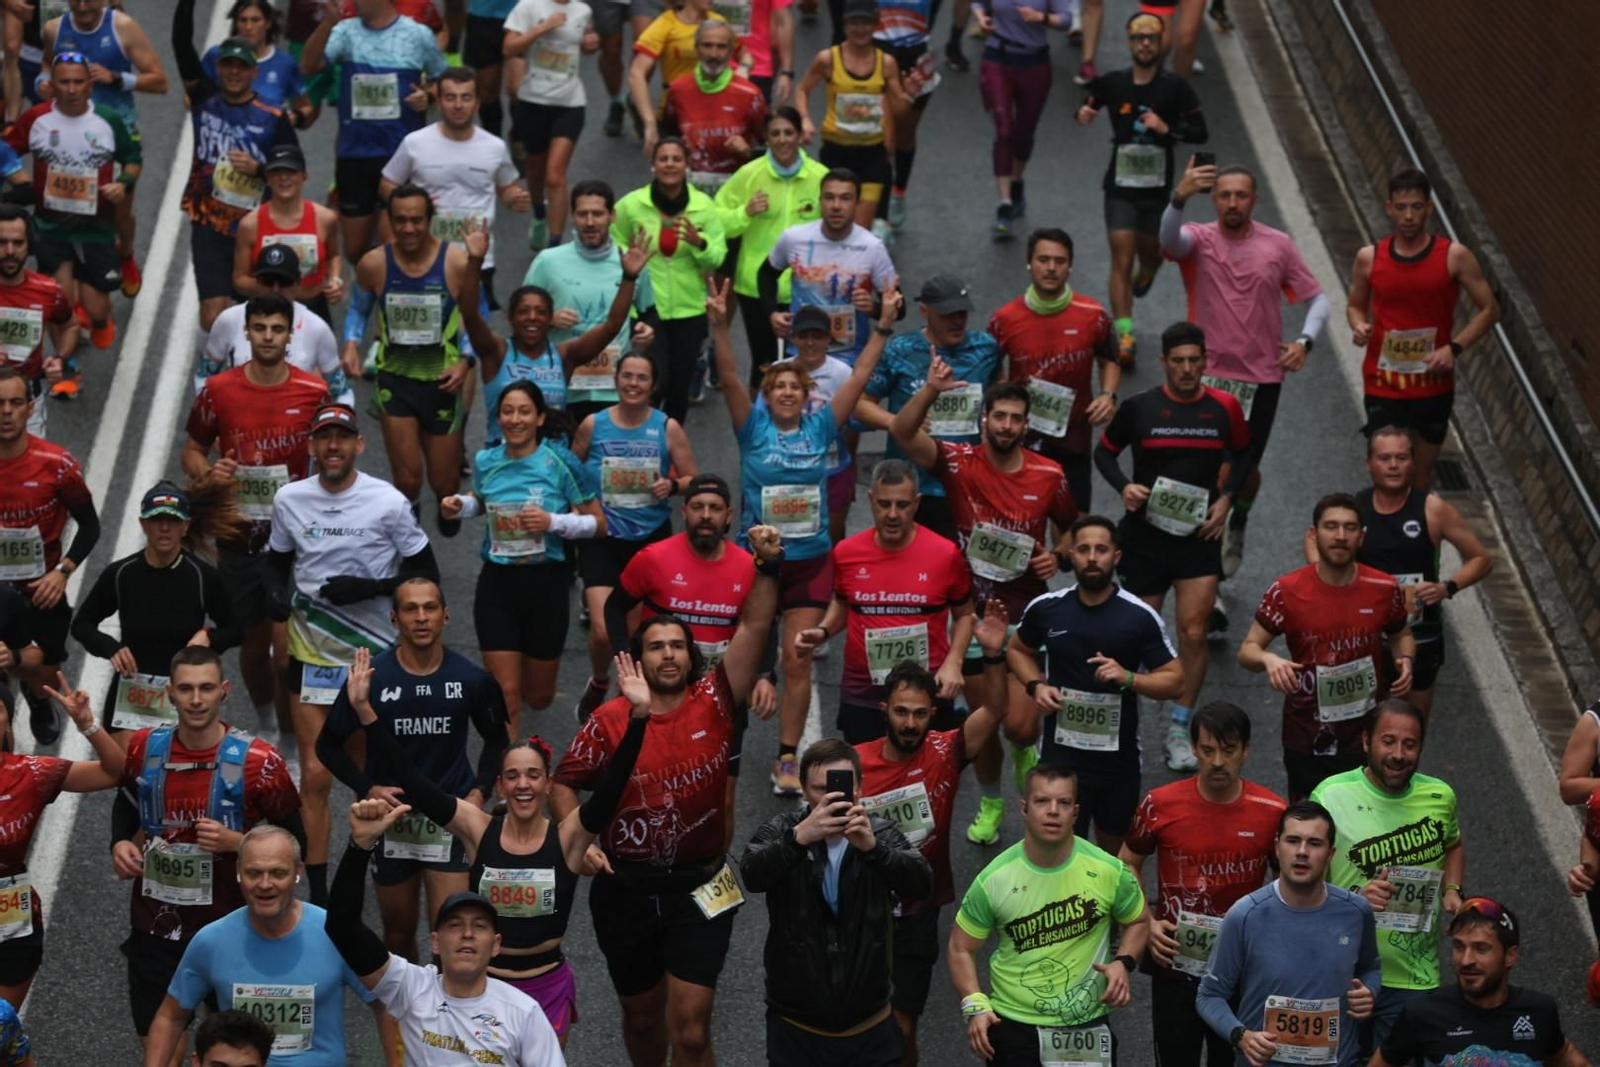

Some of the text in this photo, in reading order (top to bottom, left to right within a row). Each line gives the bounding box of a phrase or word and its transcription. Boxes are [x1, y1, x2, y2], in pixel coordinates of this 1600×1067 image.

[394, 307, 429, 324] 8073
[1151, 427, 1219, 440] PRORUNNERS
[1159, 491, 1196, 514] 9274
[322, 527, 366, 538] TRAILRACE
[978, 536, 1018, 561] 9477
[855, 590, 929, 604] Los Lentos
[875, 640, 916, 661] 7726
[415, 685, 442, 699] FFA
[445, 681, 464, 700] CR
[1327, 670, 1366, 696] 7809
[126, 686, 166, 708] 8671
[1066, 703, 1107, 726] 8996
[394, 716, 452, 736] FRANCE
[617, 818, 648, 846] 30
[1358, 824, 1442, 864] TORTUGAS
[1396, 844, 1444, 866] ENSANCHE
[153, 859, 196, 881] 9695
[489, 885, 537, 906] 8849
[1010, 898, 1086, 942] TORTUGAS
[1037, 919, 1091, 948] ENSANCHE
[240, 1002, 301, 1024] 10312
[1275, 1013, 1324, 1037] 5819
[1051, 1031, 1095, 1052] 6760
